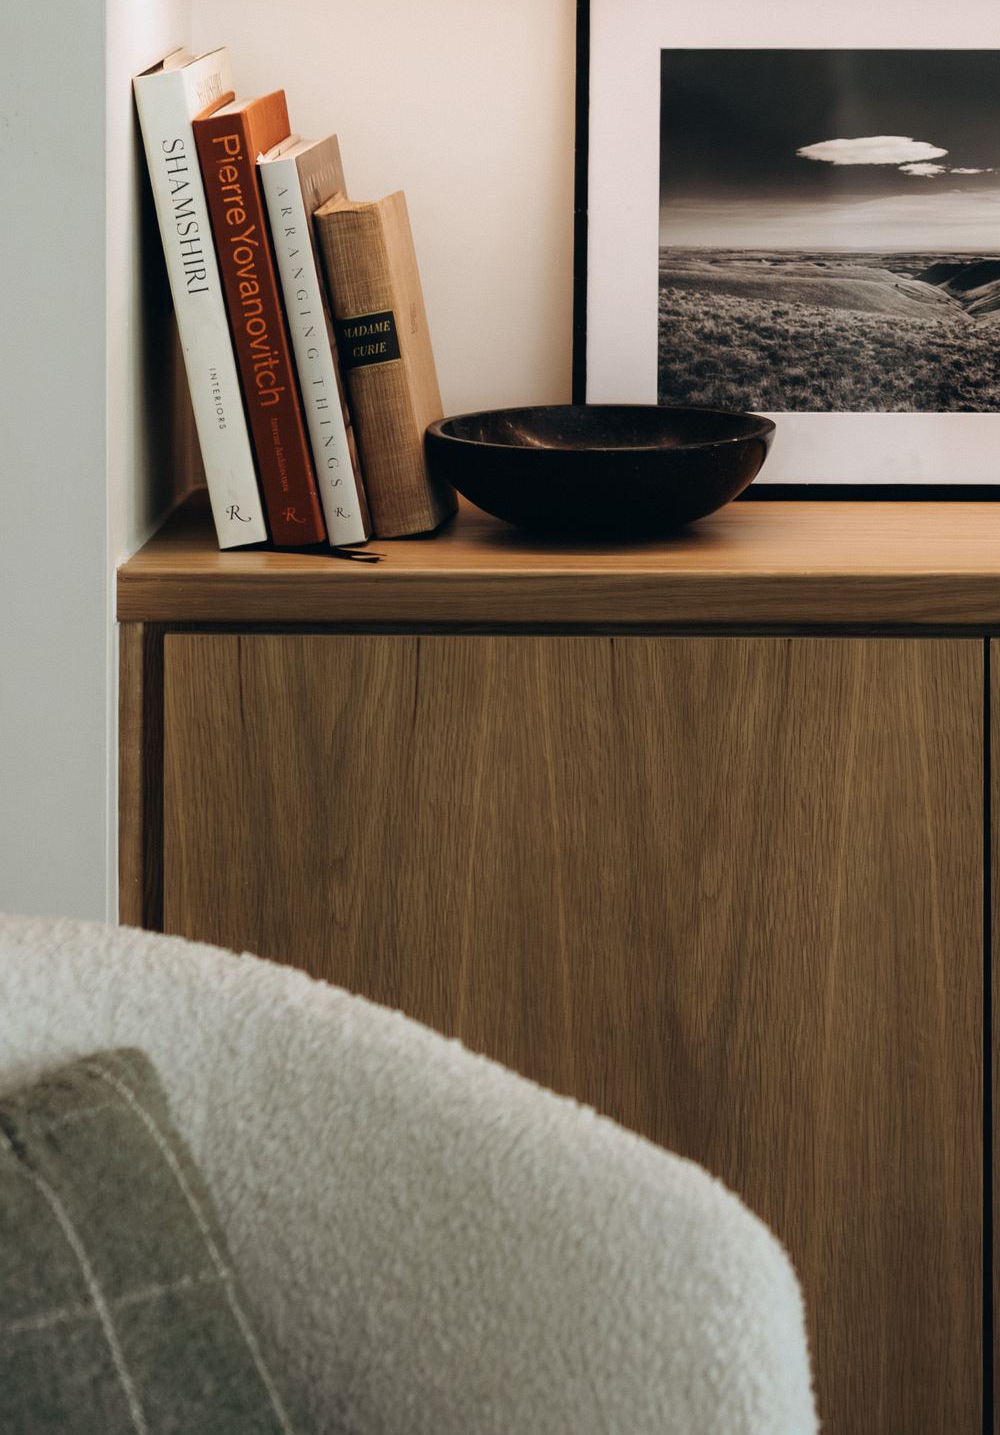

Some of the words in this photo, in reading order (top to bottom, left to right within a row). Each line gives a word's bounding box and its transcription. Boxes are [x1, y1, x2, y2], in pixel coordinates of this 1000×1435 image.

[162, 138, 209, 294] SHAMSHIRI
[212, 133, 247, 226] Pierre
[230, 224, 286, 409] Yovanovitch
[277, 186, 320, 360] ARRANGING
[313, 378, 343, 488] THINGS
[344, 319, 391, 339] MADAME
[353, 341, 387, 357] CURIE
[208, 367, 227, 430] INTERIORS
